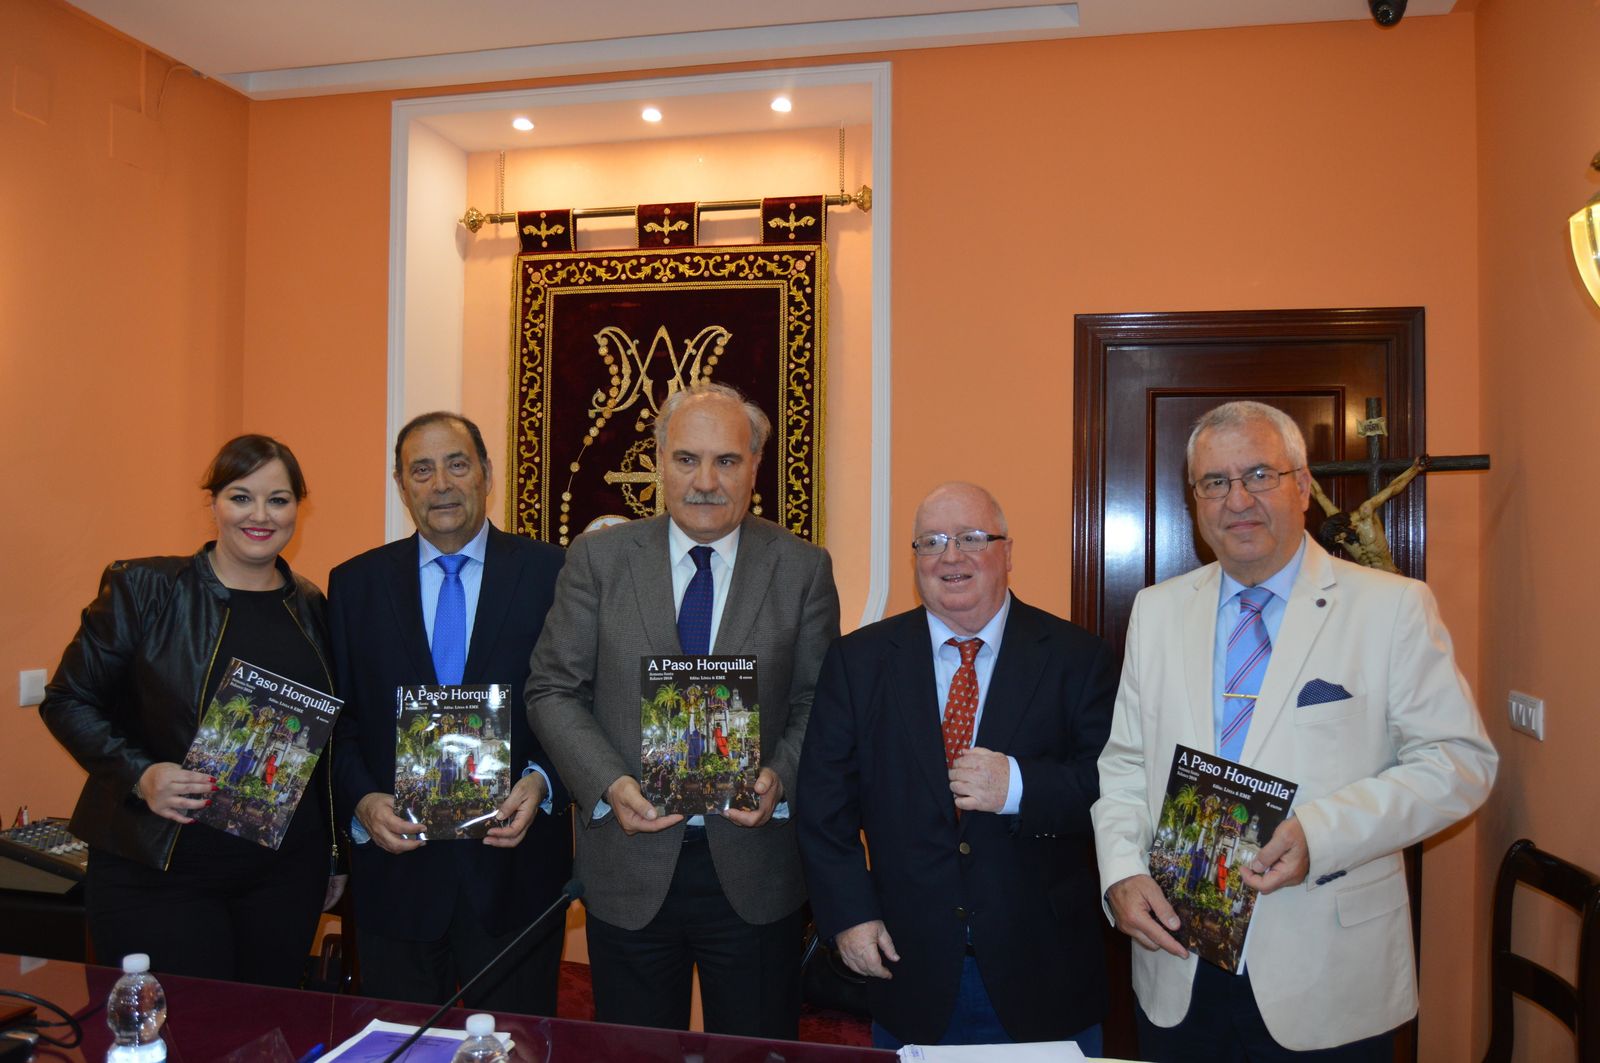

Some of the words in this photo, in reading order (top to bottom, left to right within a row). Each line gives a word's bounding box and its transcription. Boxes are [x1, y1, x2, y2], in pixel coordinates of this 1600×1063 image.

[648, 659, 658, 671] A
[662, 659, 693, 671] Paso
[232, 666, 244, 679] A
[248, 671, 278, 692] Paso
[404, 689, 415, 701] A
[418, 689, 448, 701] Paso
[1178, 752, 1188, 766] A
[1191, 754, 1221, 776] Paso
